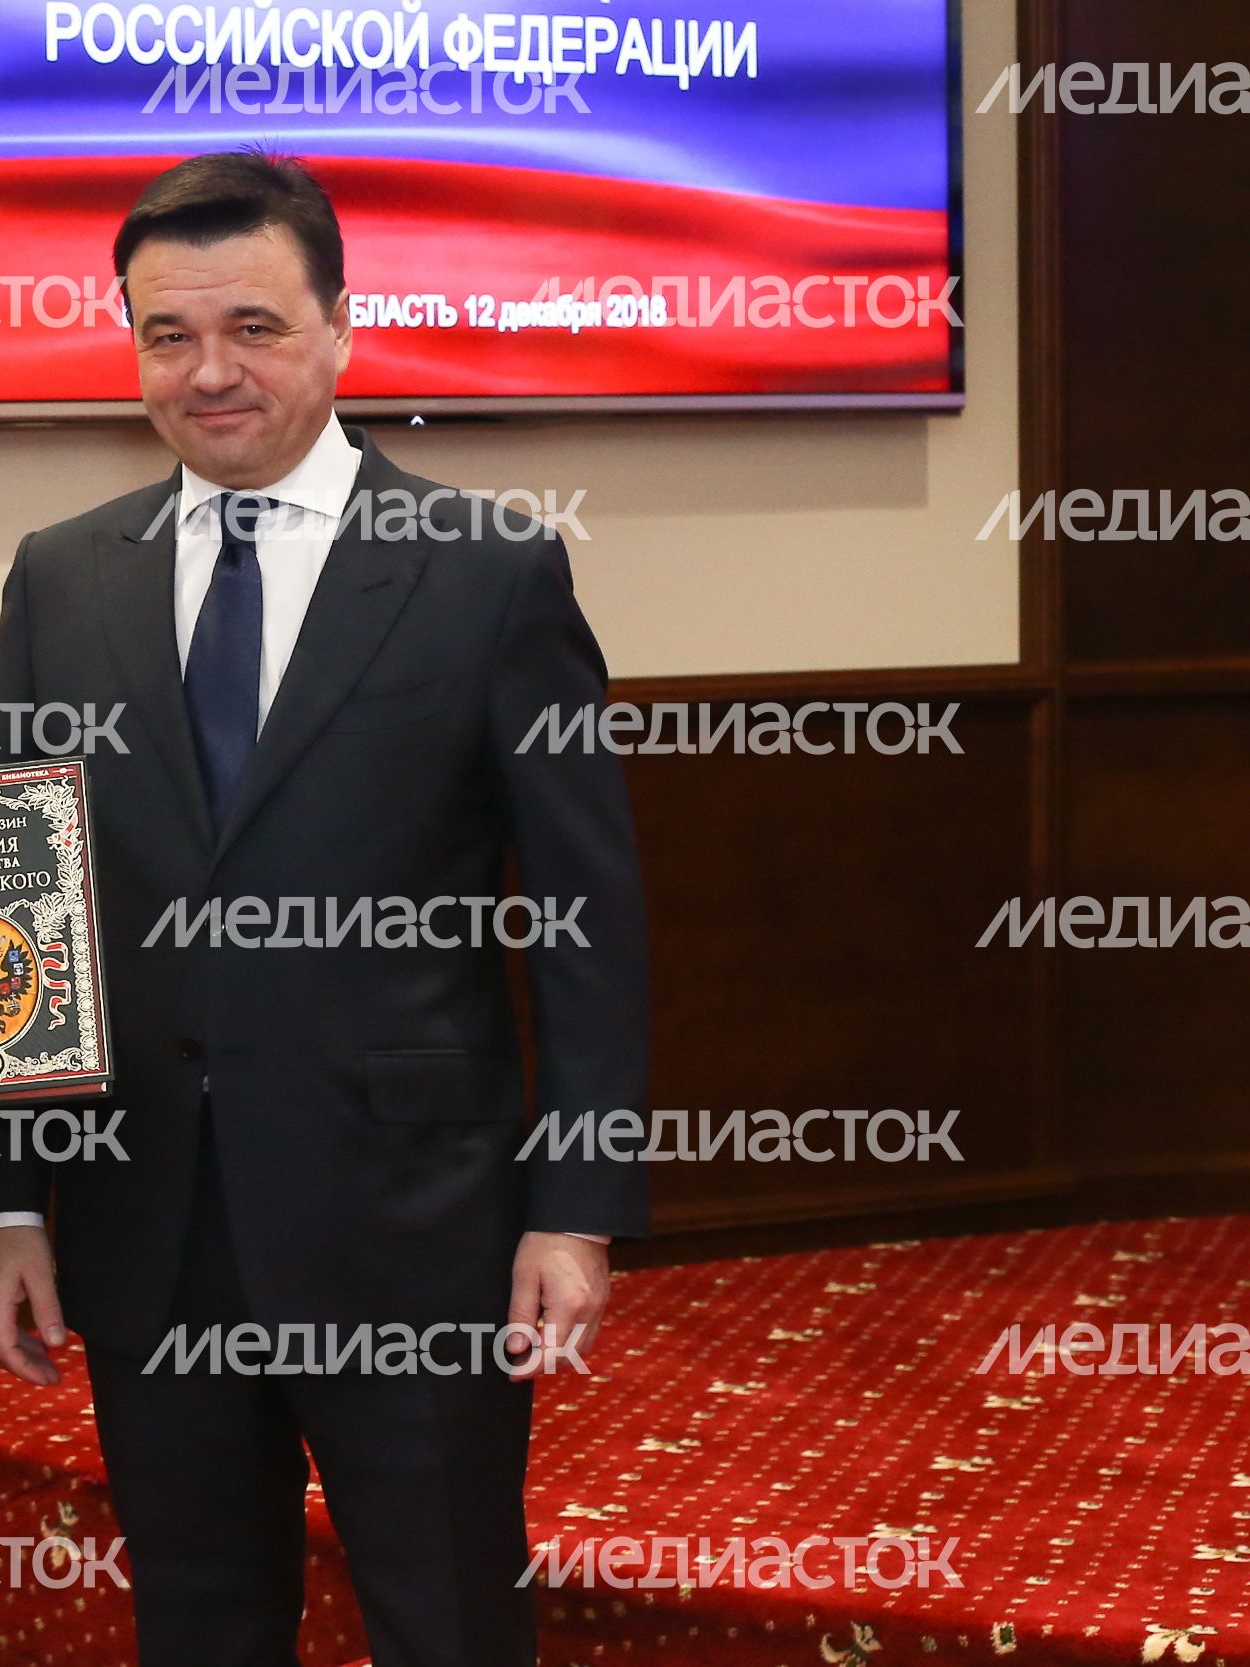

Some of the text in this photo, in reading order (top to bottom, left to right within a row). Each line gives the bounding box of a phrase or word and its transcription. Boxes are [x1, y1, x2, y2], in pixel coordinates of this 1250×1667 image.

[46, 0, 758, 91] РОССИЙСКОЙ ФЕДЕРАЦИИ
[350, 294, 668, 334] БЛАСТЬ 12 декабря 2018
[2, 770, 50, 781] БИБЛИОТЕКА
